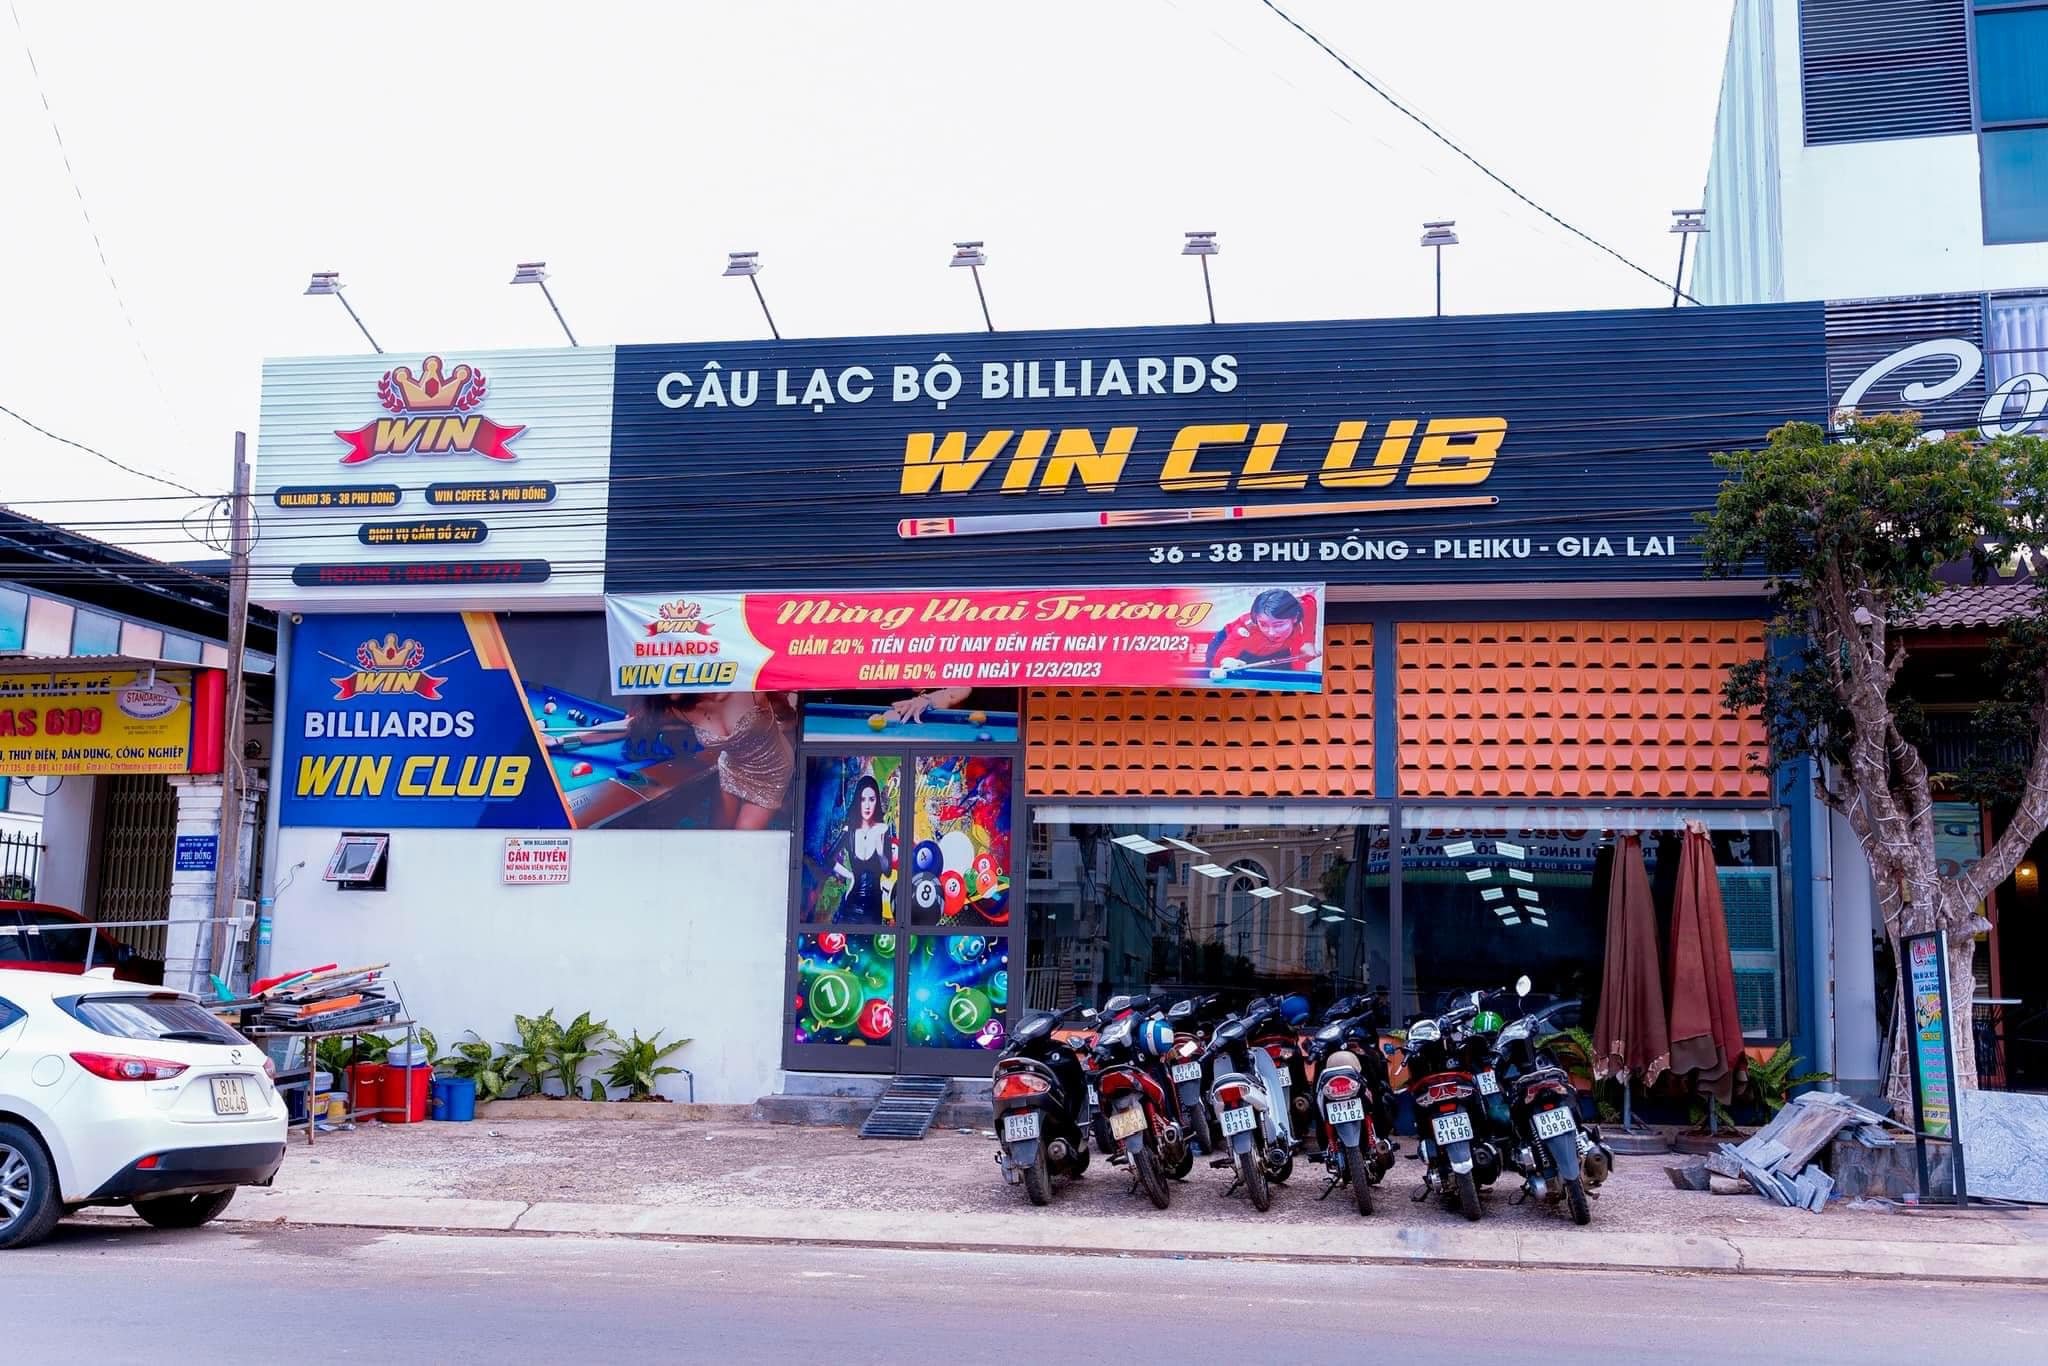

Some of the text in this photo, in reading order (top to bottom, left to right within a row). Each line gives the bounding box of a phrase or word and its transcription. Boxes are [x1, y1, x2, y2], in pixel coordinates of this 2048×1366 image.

[656, 353, 1238, 413] CÂU LẠC BỘ BILLIARDS
[373, 416, 483, 453] WIN
[900, 416, 1508, 495] WIN CLUB
[280, 493, 318, 506] BILLIARD
[320, 493, 332, 505] 36
[339, 492, 350, 504] 38
[434, 490, 454, 502] WIN
[455, 489, 487, 502] COFFEE
[489, 488, 500, 500] 34
[454, 527, 478, 540] 24/7
[1149, 546, 1185, 564] 36
[1208, 543, 1243, 562] 38
[1434, 538, 1531, 559] PLEIKU
[1557, 536, 1615, 557] GIA
[1627, 535, 1676, 557] LAI
[776, 594, 1214, 630] Mừng Khai Trương
[656, 619, 698, 633] WIN
[635, 641, 720, 657] BILLIARDS
[787, 634, 828, 656] GIẢM
[831, 638, 865, 656] 20%
[960, 636, 992, 652] NAY
[994, 632, 1027, 652] ĐẾN
[1031, 630, 1062, 652] HẾT
[1064, 631, 1109, 652] NGÀY
[1112, 635, 1190, 652] 11/3/2023
[354, 671, 421, 694] WIN
[620, 661, 738, 688] WIN CLUB
[858, 659, 1102, 681] GIẢM 50% CHO NGÀY 12/3/2023
[45, 707, 102, 736] 609
[304, 710, 476, 738] BILLIARDS
[116, 745, 144, 760] CÔNG
[297, 755, 532, 798] WIN CLUB
[921, 884, 932, 901] 8
[820, 981, 837, 1008] 1
[220, 1079, 238, 1095] 81A
